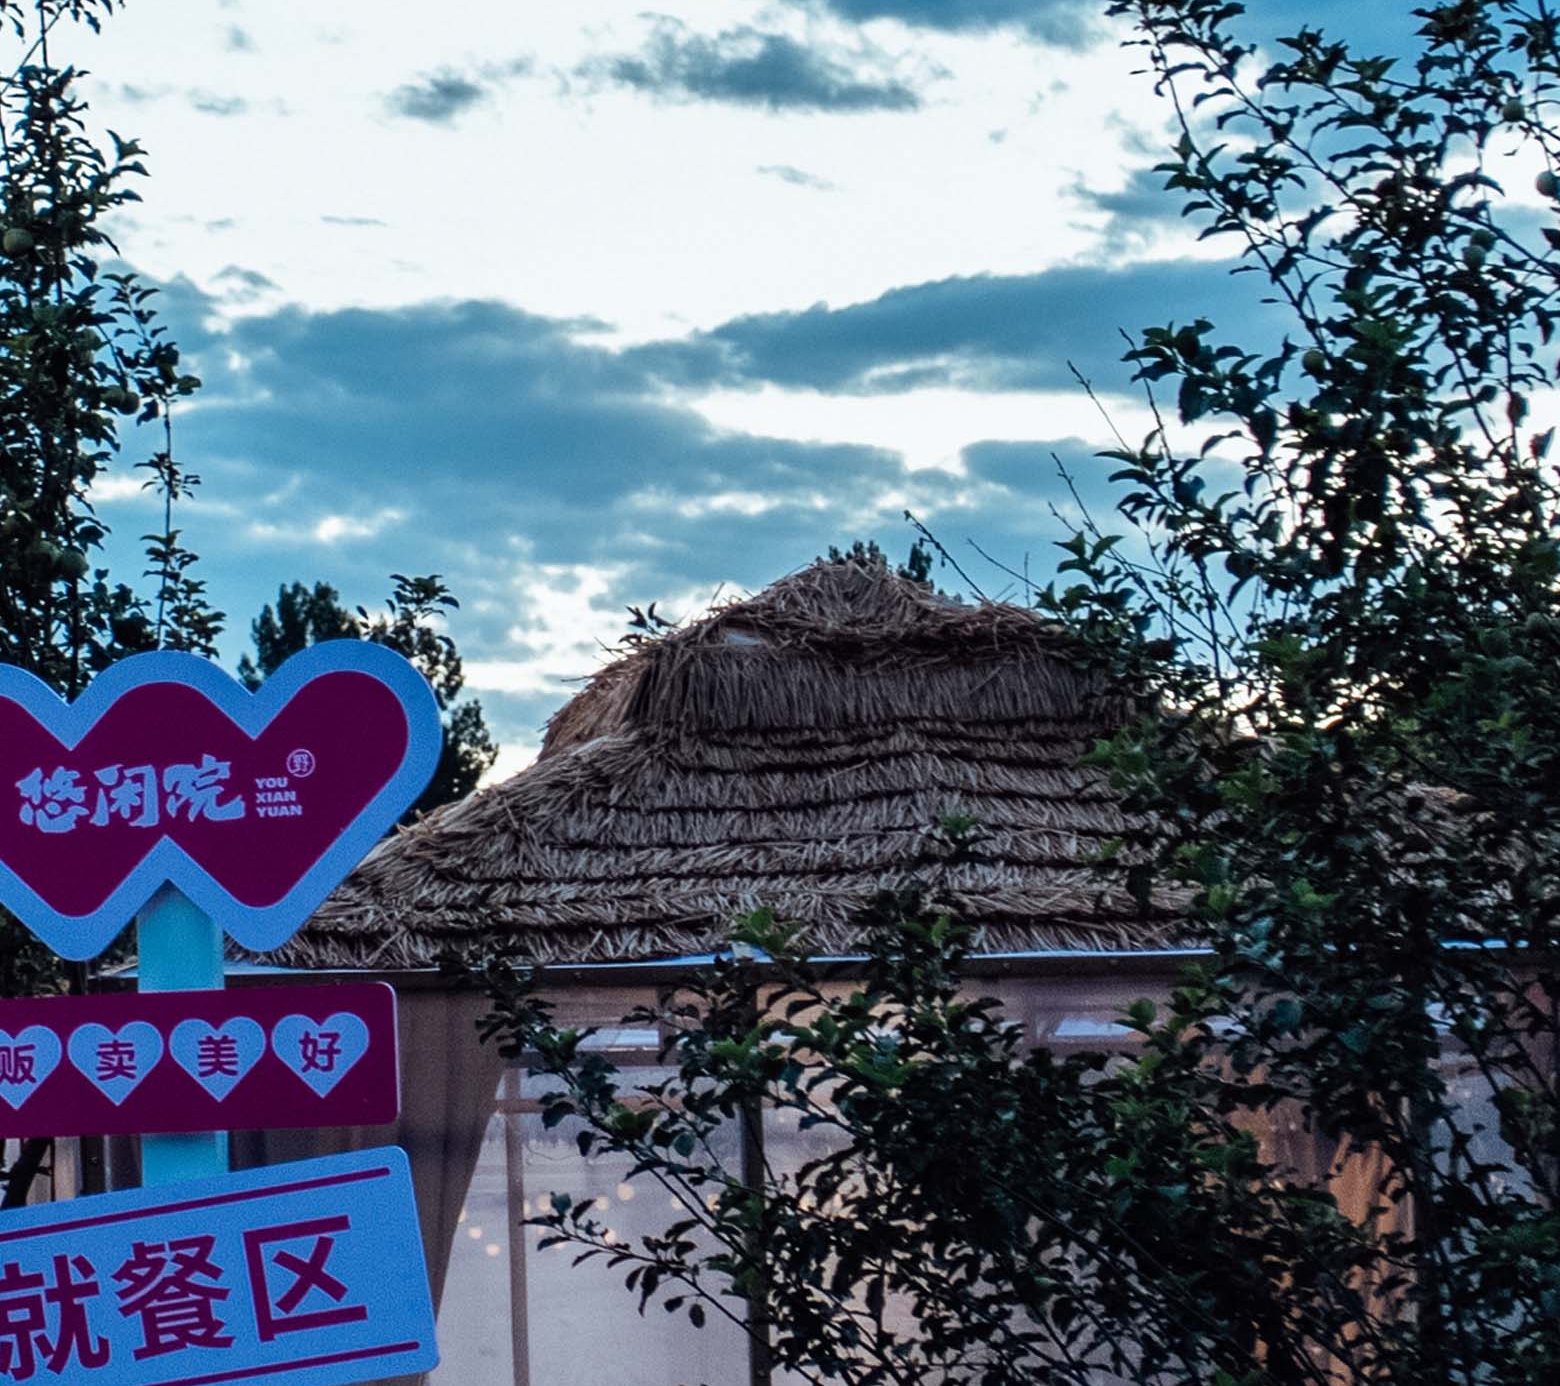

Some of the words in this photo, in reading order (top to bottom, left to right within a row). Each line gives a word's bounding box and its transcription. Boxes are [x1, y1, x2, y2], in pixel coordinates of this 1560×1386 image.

[255, 777, 288, 789] YOU
[15, 754, 246, 833] 悠闲院
[256, 791, 297, 804] XIAN
[256, 804, 303, 818] YUAN
